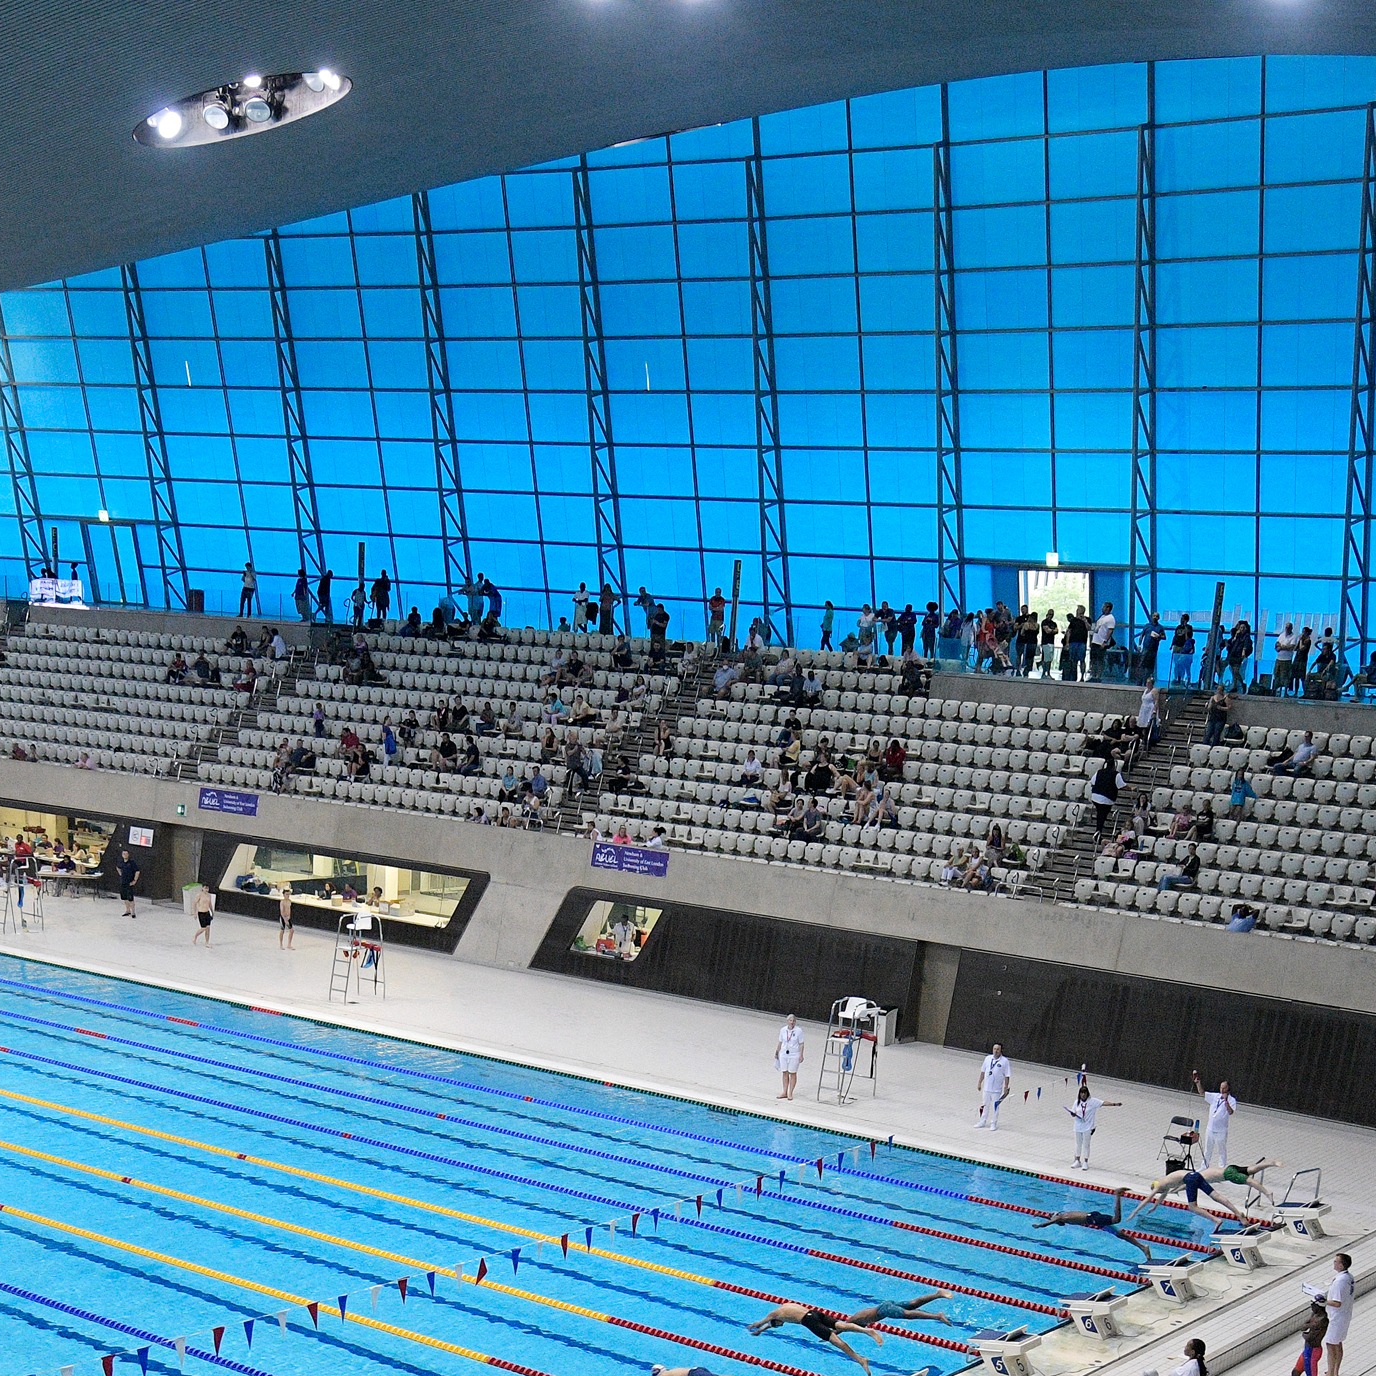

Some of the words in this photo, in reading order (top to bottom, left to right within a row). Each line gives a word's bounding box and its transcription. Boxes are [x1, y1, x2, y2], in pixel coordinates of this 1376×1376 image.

[1296, 1223, 1304, 1232] 9
[1233, 1251, 1241, 1260] 8
[1164, 1283, 1171, 1292] 7
[1085, 1318, 1092, 1329] 6
[1103, 1317, 1112, 1330] 6
[995, 1360, 1003, 1371] 5
[1016, 1358, 1024, 1372] 5
